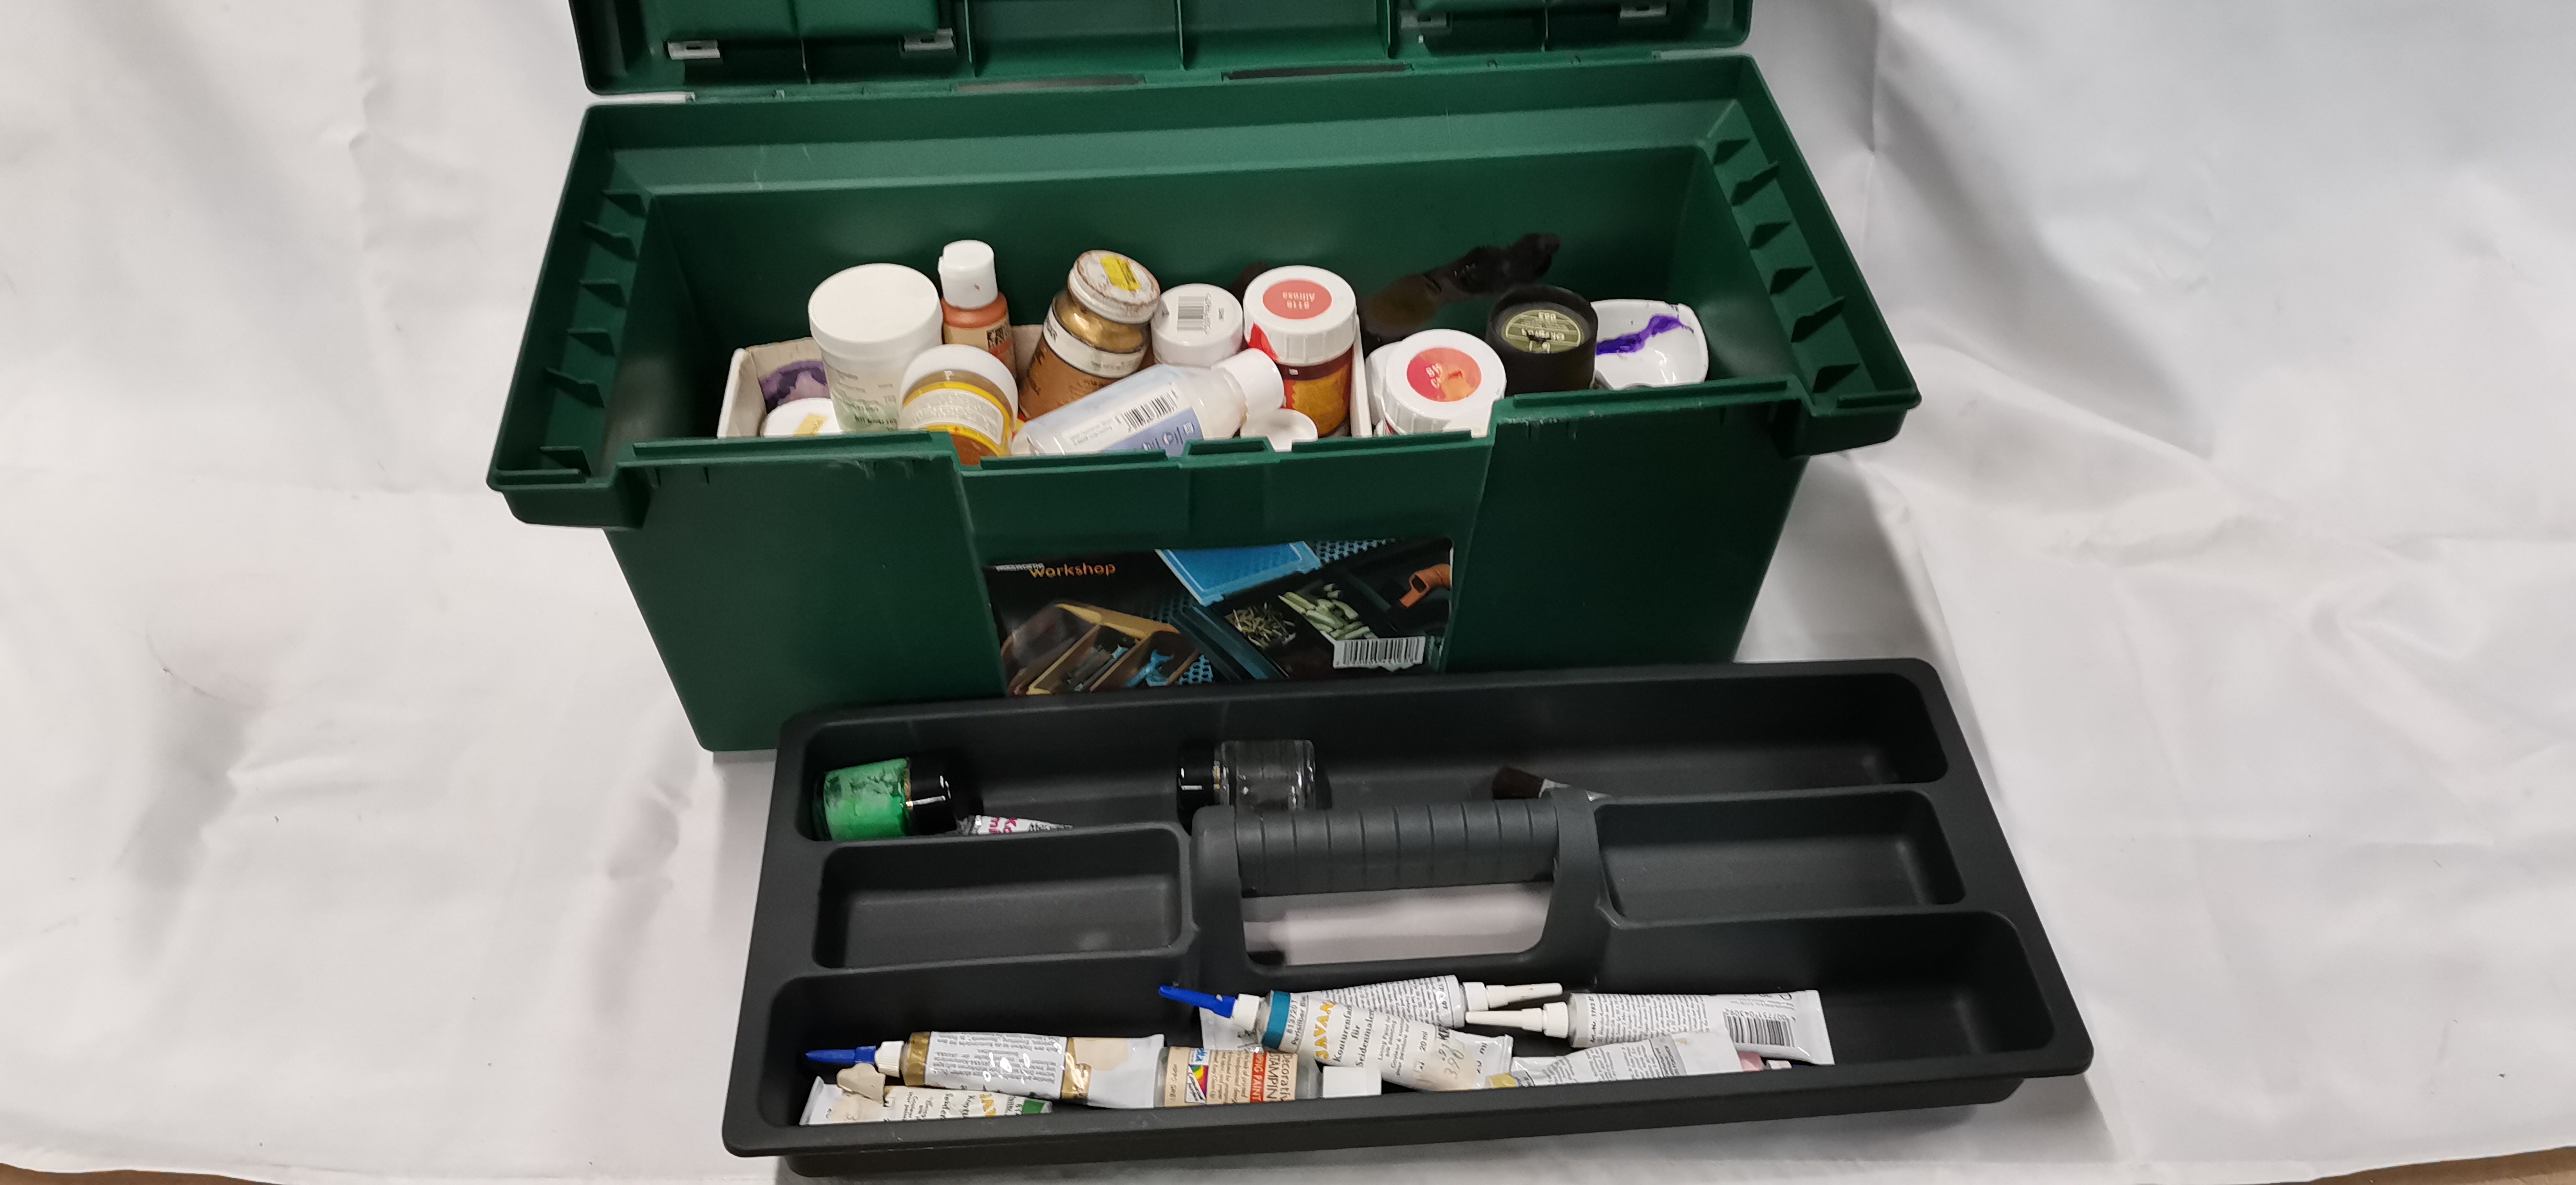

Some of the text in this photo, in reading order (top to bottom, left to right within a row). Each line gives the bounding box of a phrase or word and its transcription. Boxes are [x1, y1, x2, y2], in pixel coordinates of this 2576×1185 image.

[1029, 562, 1116, 578] Workshop
[1351, 1024, 1361, 1039] für
[1252, 1073, 1263, 1101] PAINT
